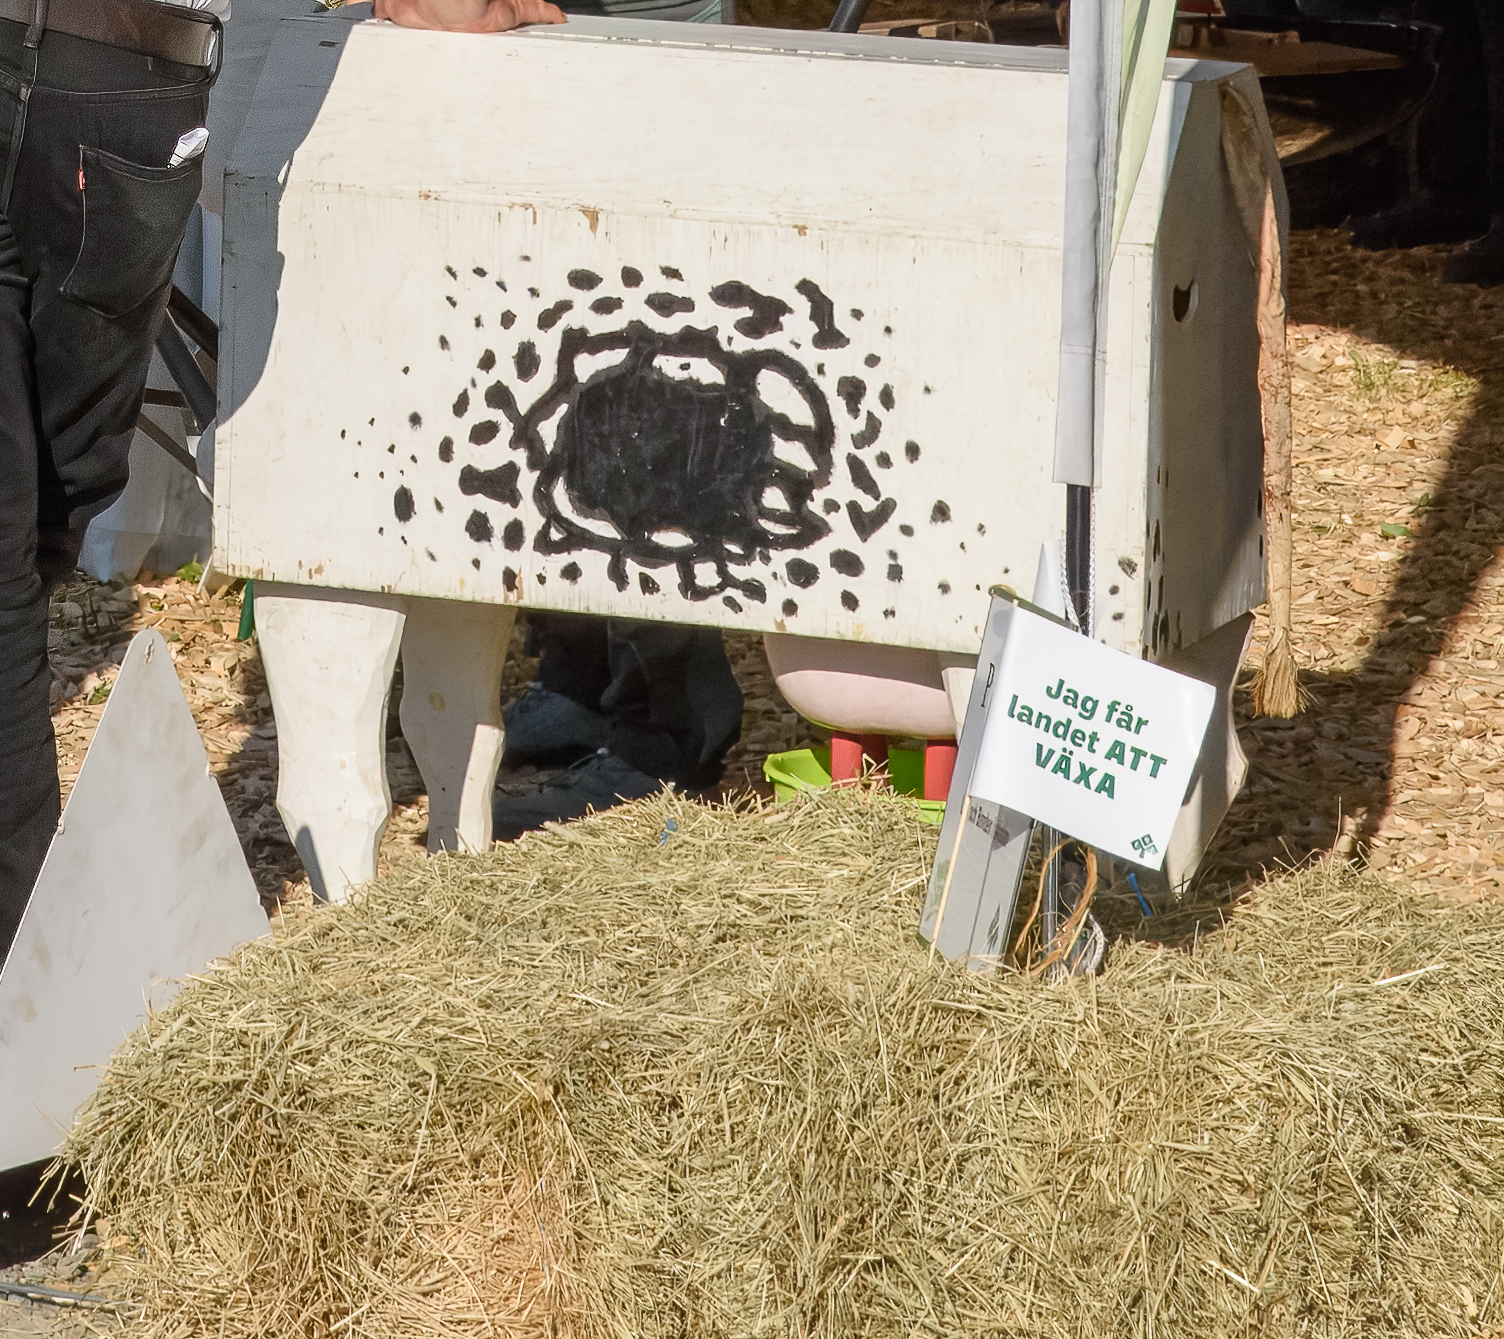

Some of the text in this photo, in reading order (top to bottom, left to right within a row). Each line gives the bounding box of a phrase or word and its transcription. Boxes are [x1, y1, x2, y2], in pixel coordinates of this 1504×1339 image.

[1045, 678, 1149, 736] Jag får
[1007, 694, 1168, 780] landet ATT
[1035, 742, 1117, 800] VÄXA
